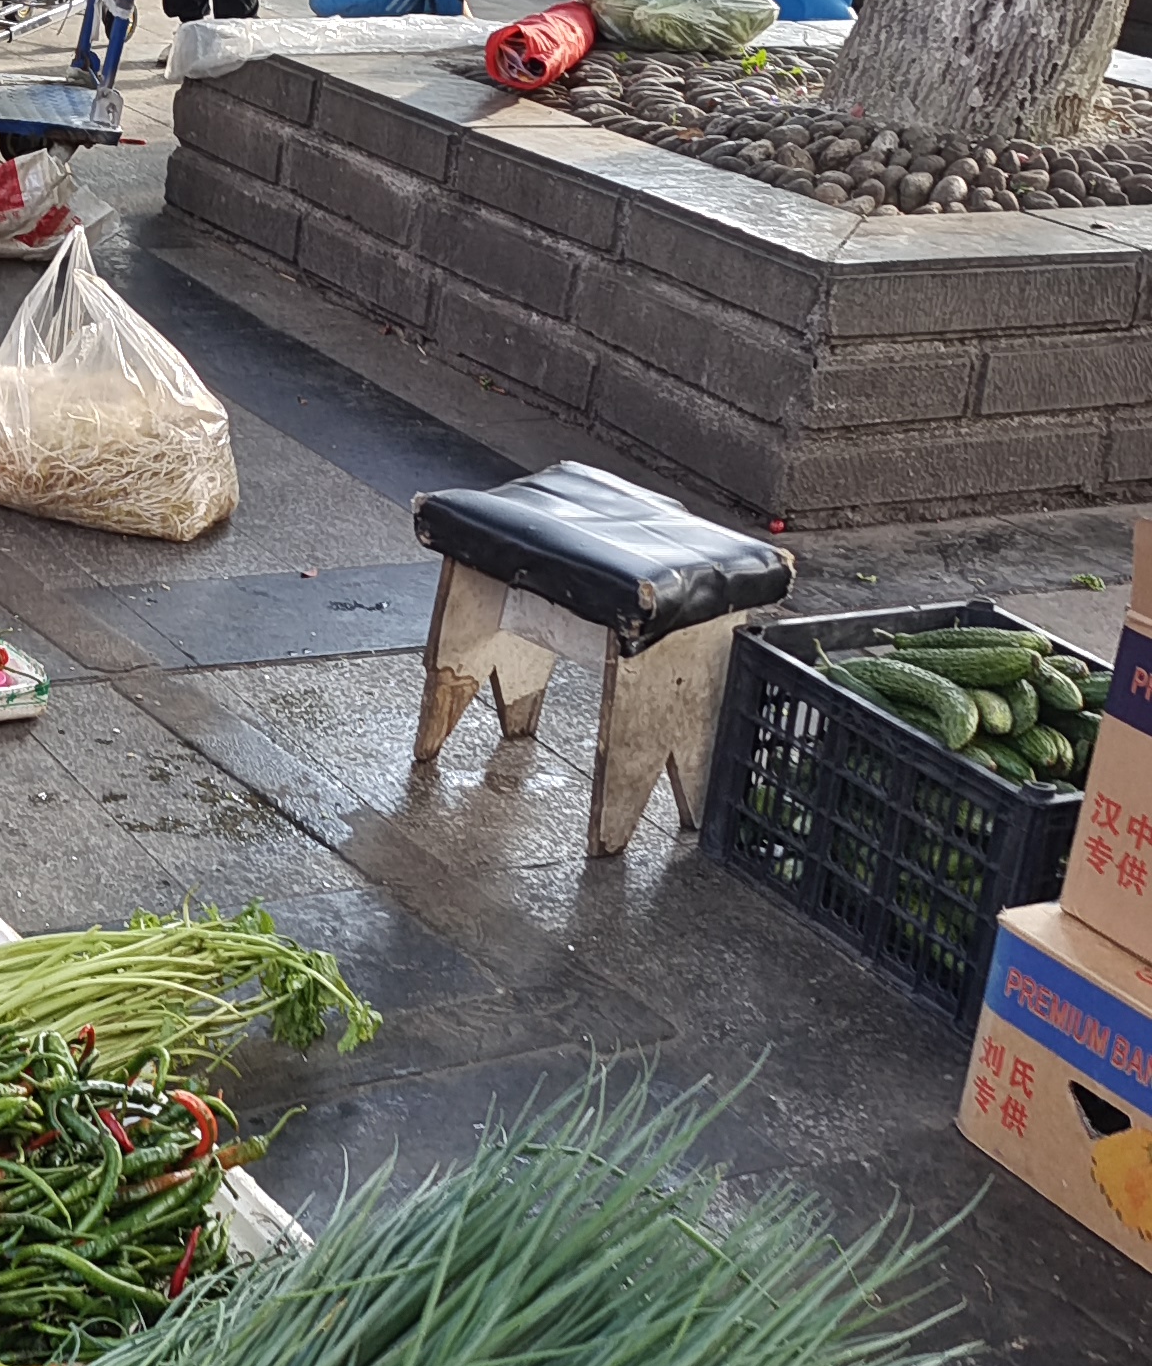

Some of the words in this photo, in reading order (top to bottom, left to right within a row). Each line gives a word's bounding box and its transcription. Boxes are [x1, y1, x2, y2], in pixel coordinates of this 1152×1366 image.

[1091, 790, 1152, 851] 汉中
[1084, 835, 1148, 897] 专供
[1004, 966, 1110, 1059] PREMIUM
[979, 1035, 1035, 1100] 刘氏
[974, 1075, 1029, 1139] 专供
